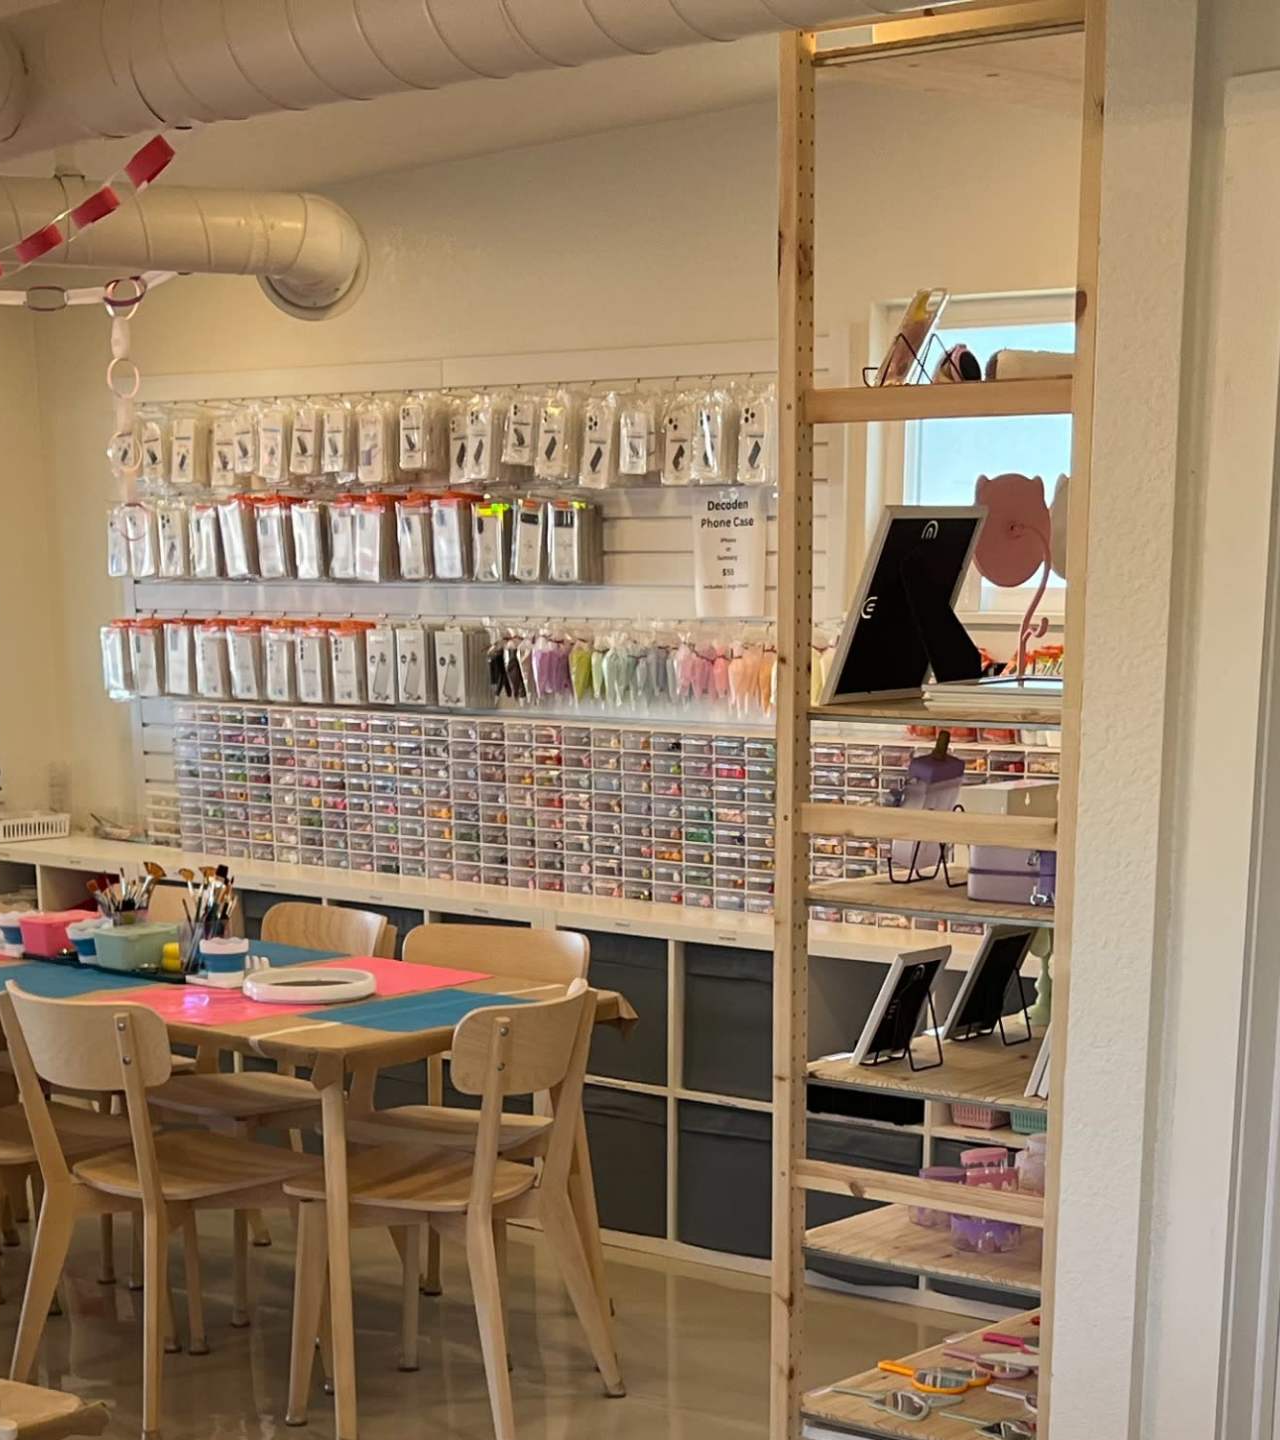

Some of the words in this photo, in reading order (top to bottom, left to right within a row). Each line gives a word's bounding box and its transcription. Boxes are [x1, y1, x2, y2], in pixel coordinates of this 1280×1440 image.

[707, 499, 749, 511] Decoden
[701, 518, 731, 528] Phone
[733, 516, 754, 527] Case
